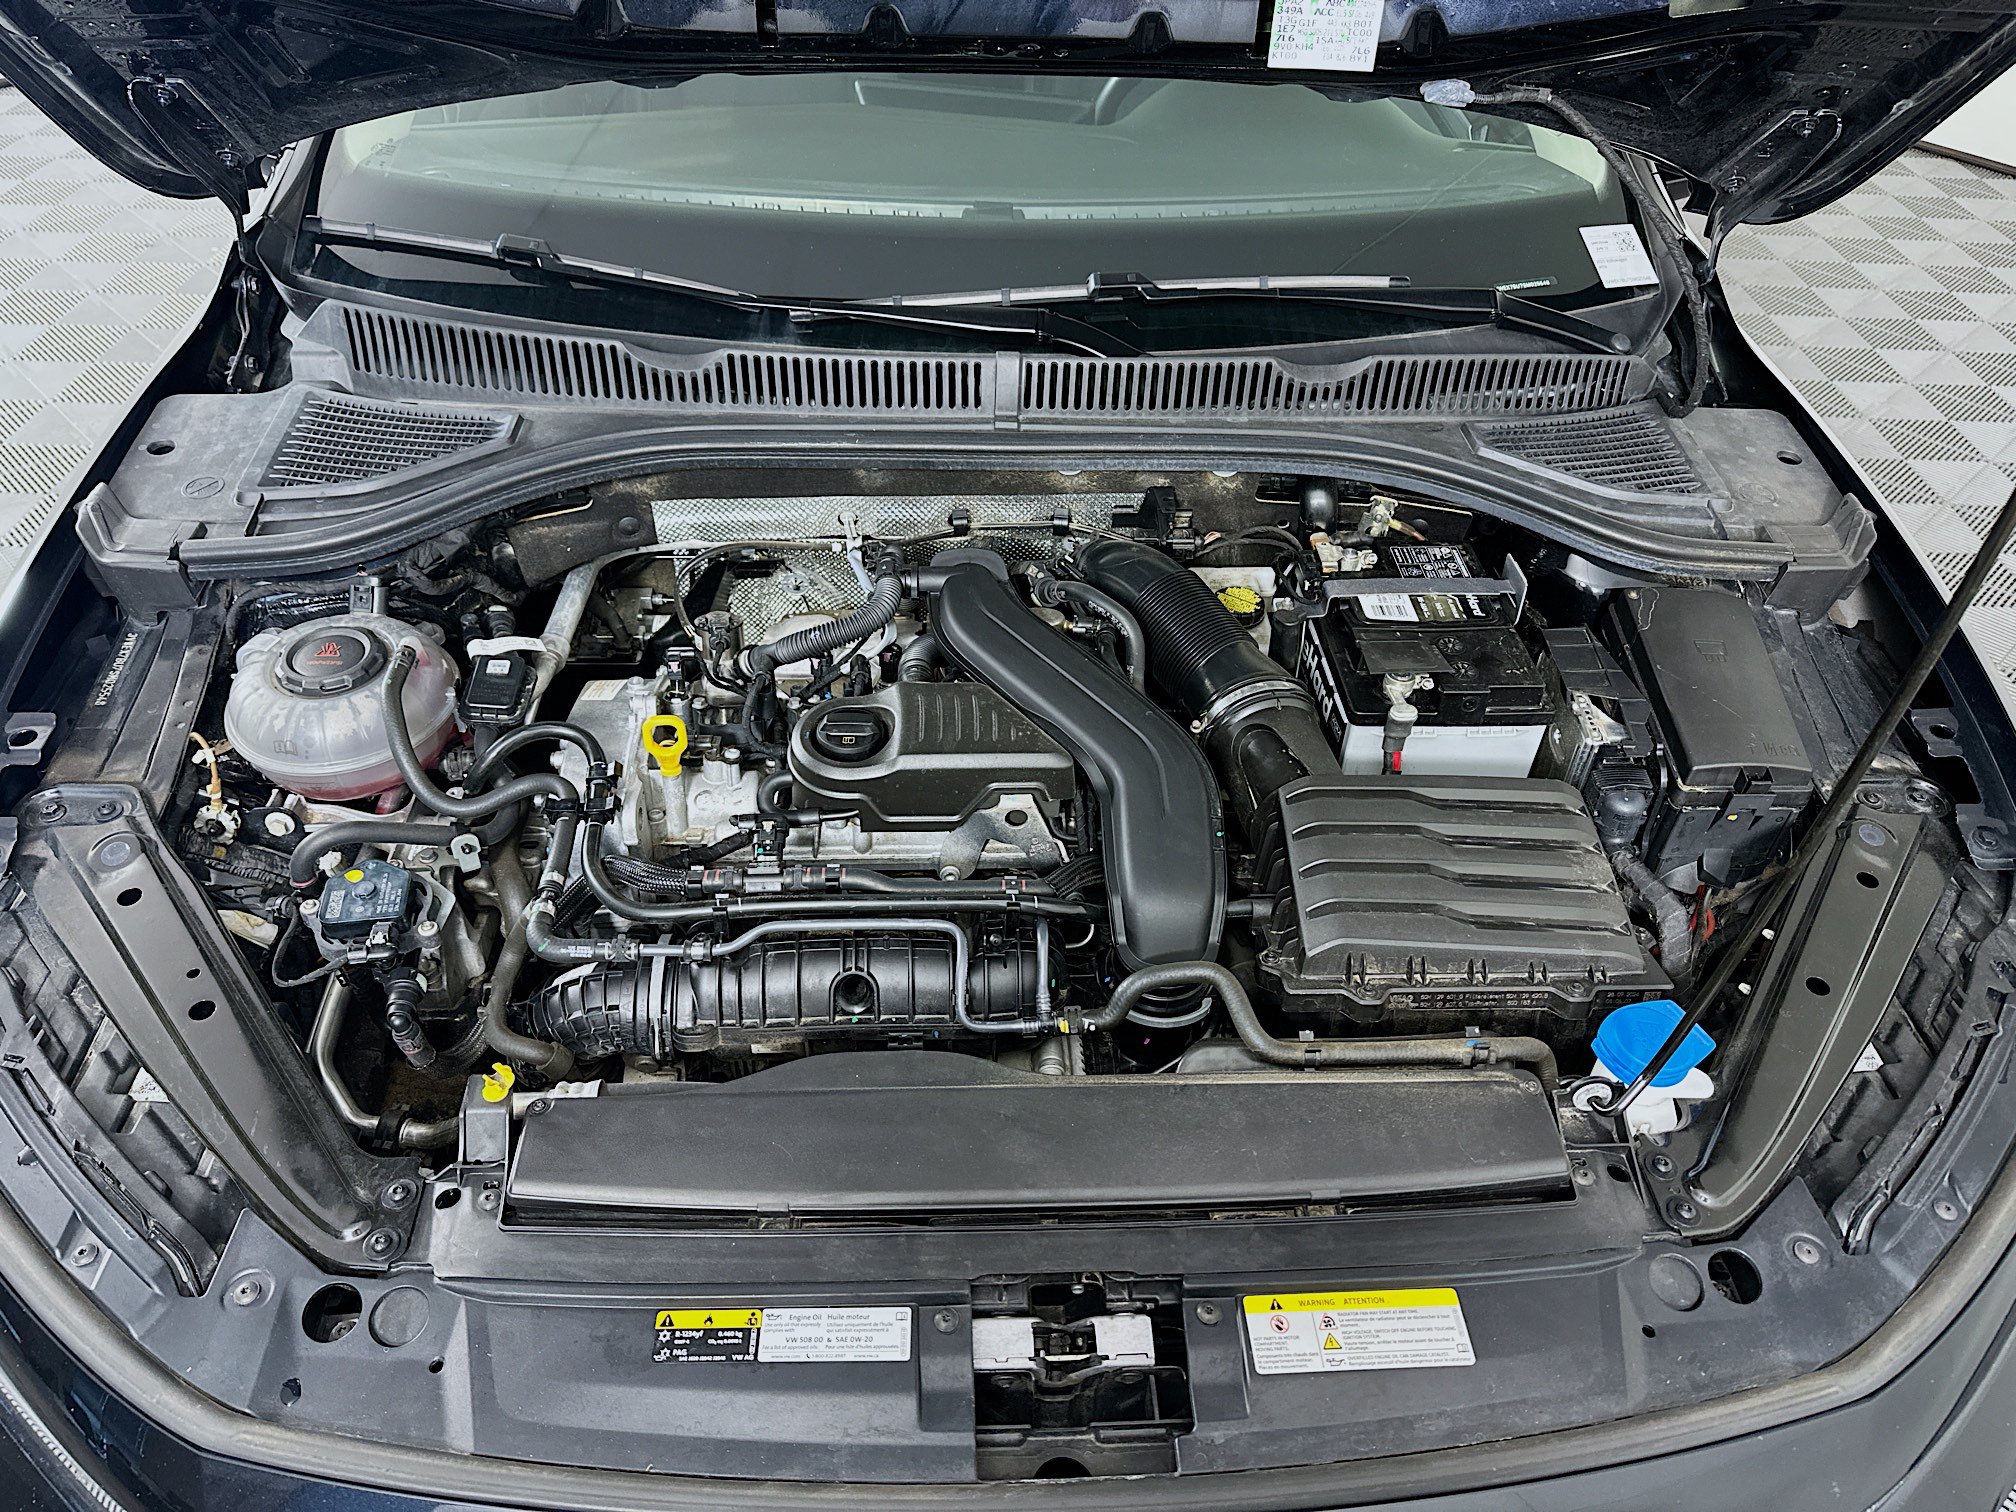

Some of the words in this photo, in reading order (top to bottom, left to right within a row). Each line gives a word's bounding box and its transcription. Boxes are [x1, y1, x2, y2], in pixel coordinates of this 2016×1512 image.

[1277, 6, 1303, 15] 349A
[1298, 1298, 1335, 1307] WARNING
[1344, 1297, 1385, 1306] ATTENTION
[789, 1314, 811, 1322] Engine
